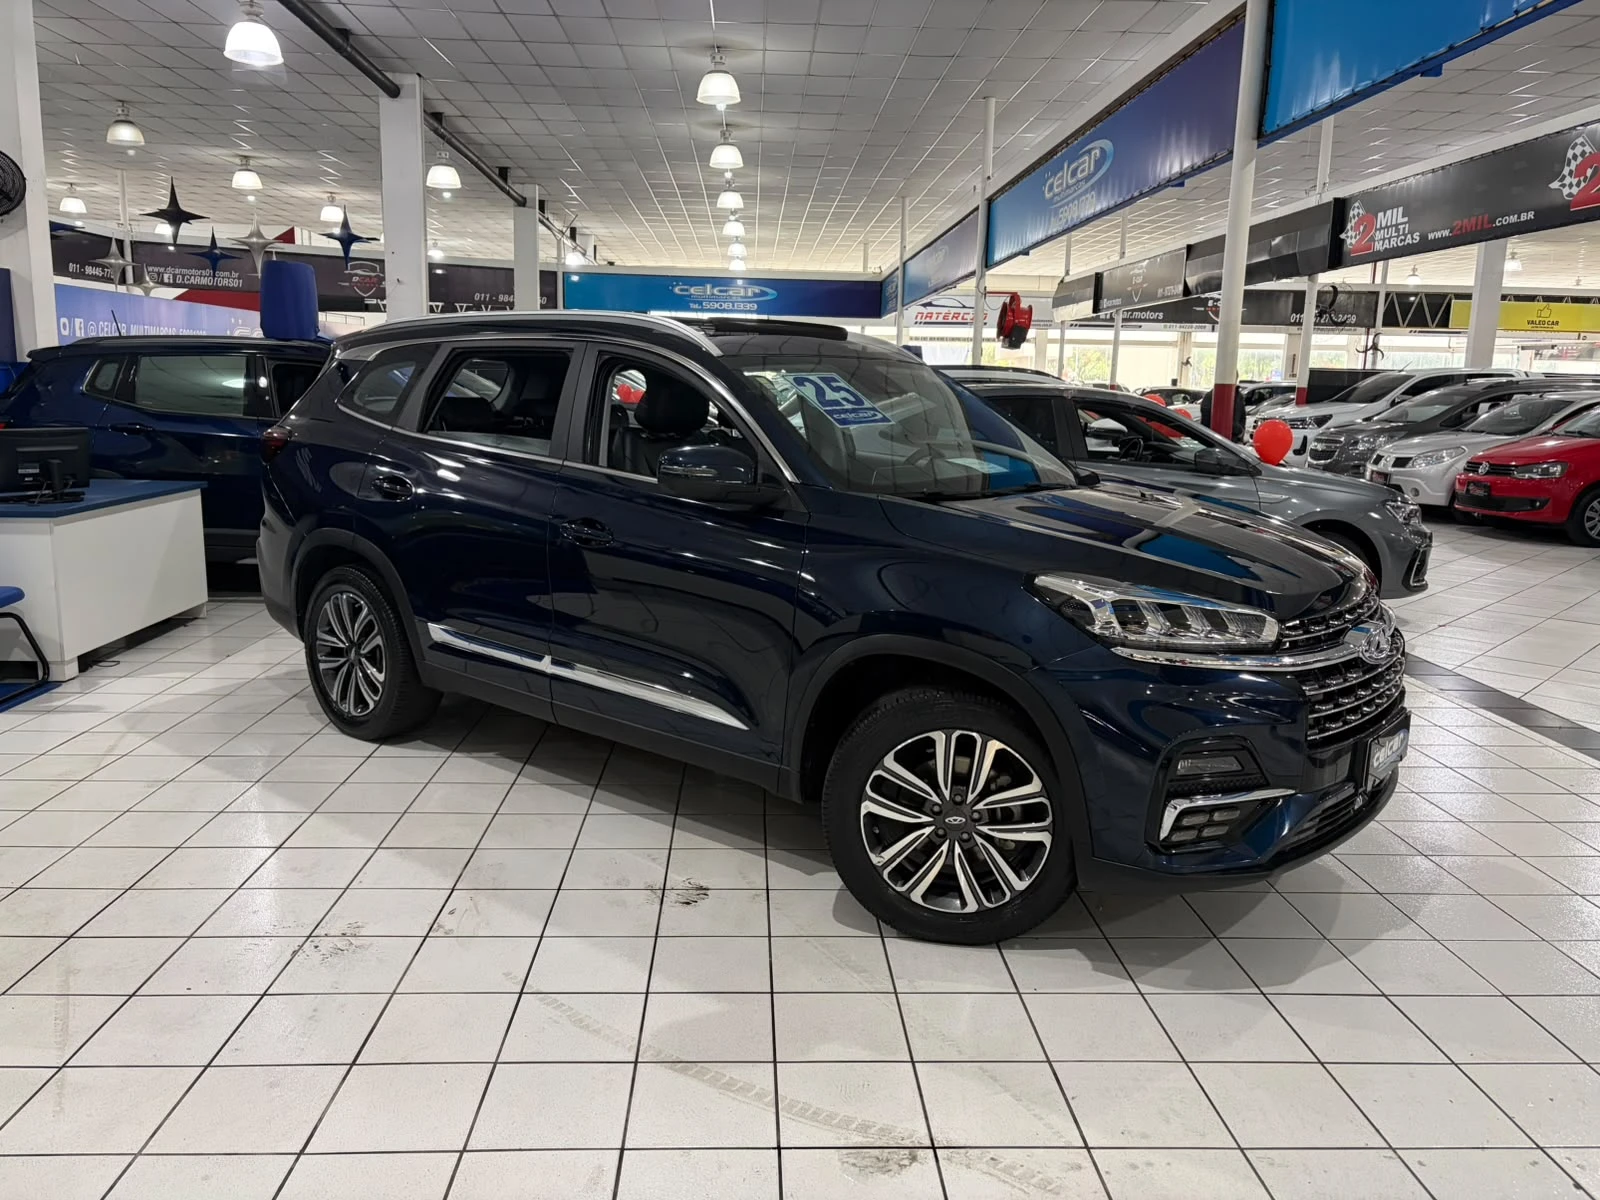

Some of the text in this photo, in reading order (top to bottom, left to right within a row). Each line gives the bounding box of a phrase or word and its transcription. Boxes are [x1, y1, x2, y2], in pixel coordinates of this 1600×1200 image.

[1045, 149, 1100, 199] celcar
[1376, 206, 1408, 228] MIL
[1350, 213, 1376, 256] 2
[1375, 223, 1409, 240] MULTI
[1374, 232, 1420, 251] MARCAS
[68, 263, 80, 272] 011
[474, 293, 490, 302] 011
[673, 283, 761, 297] celcar
[793, 376, 865, 407] 25
